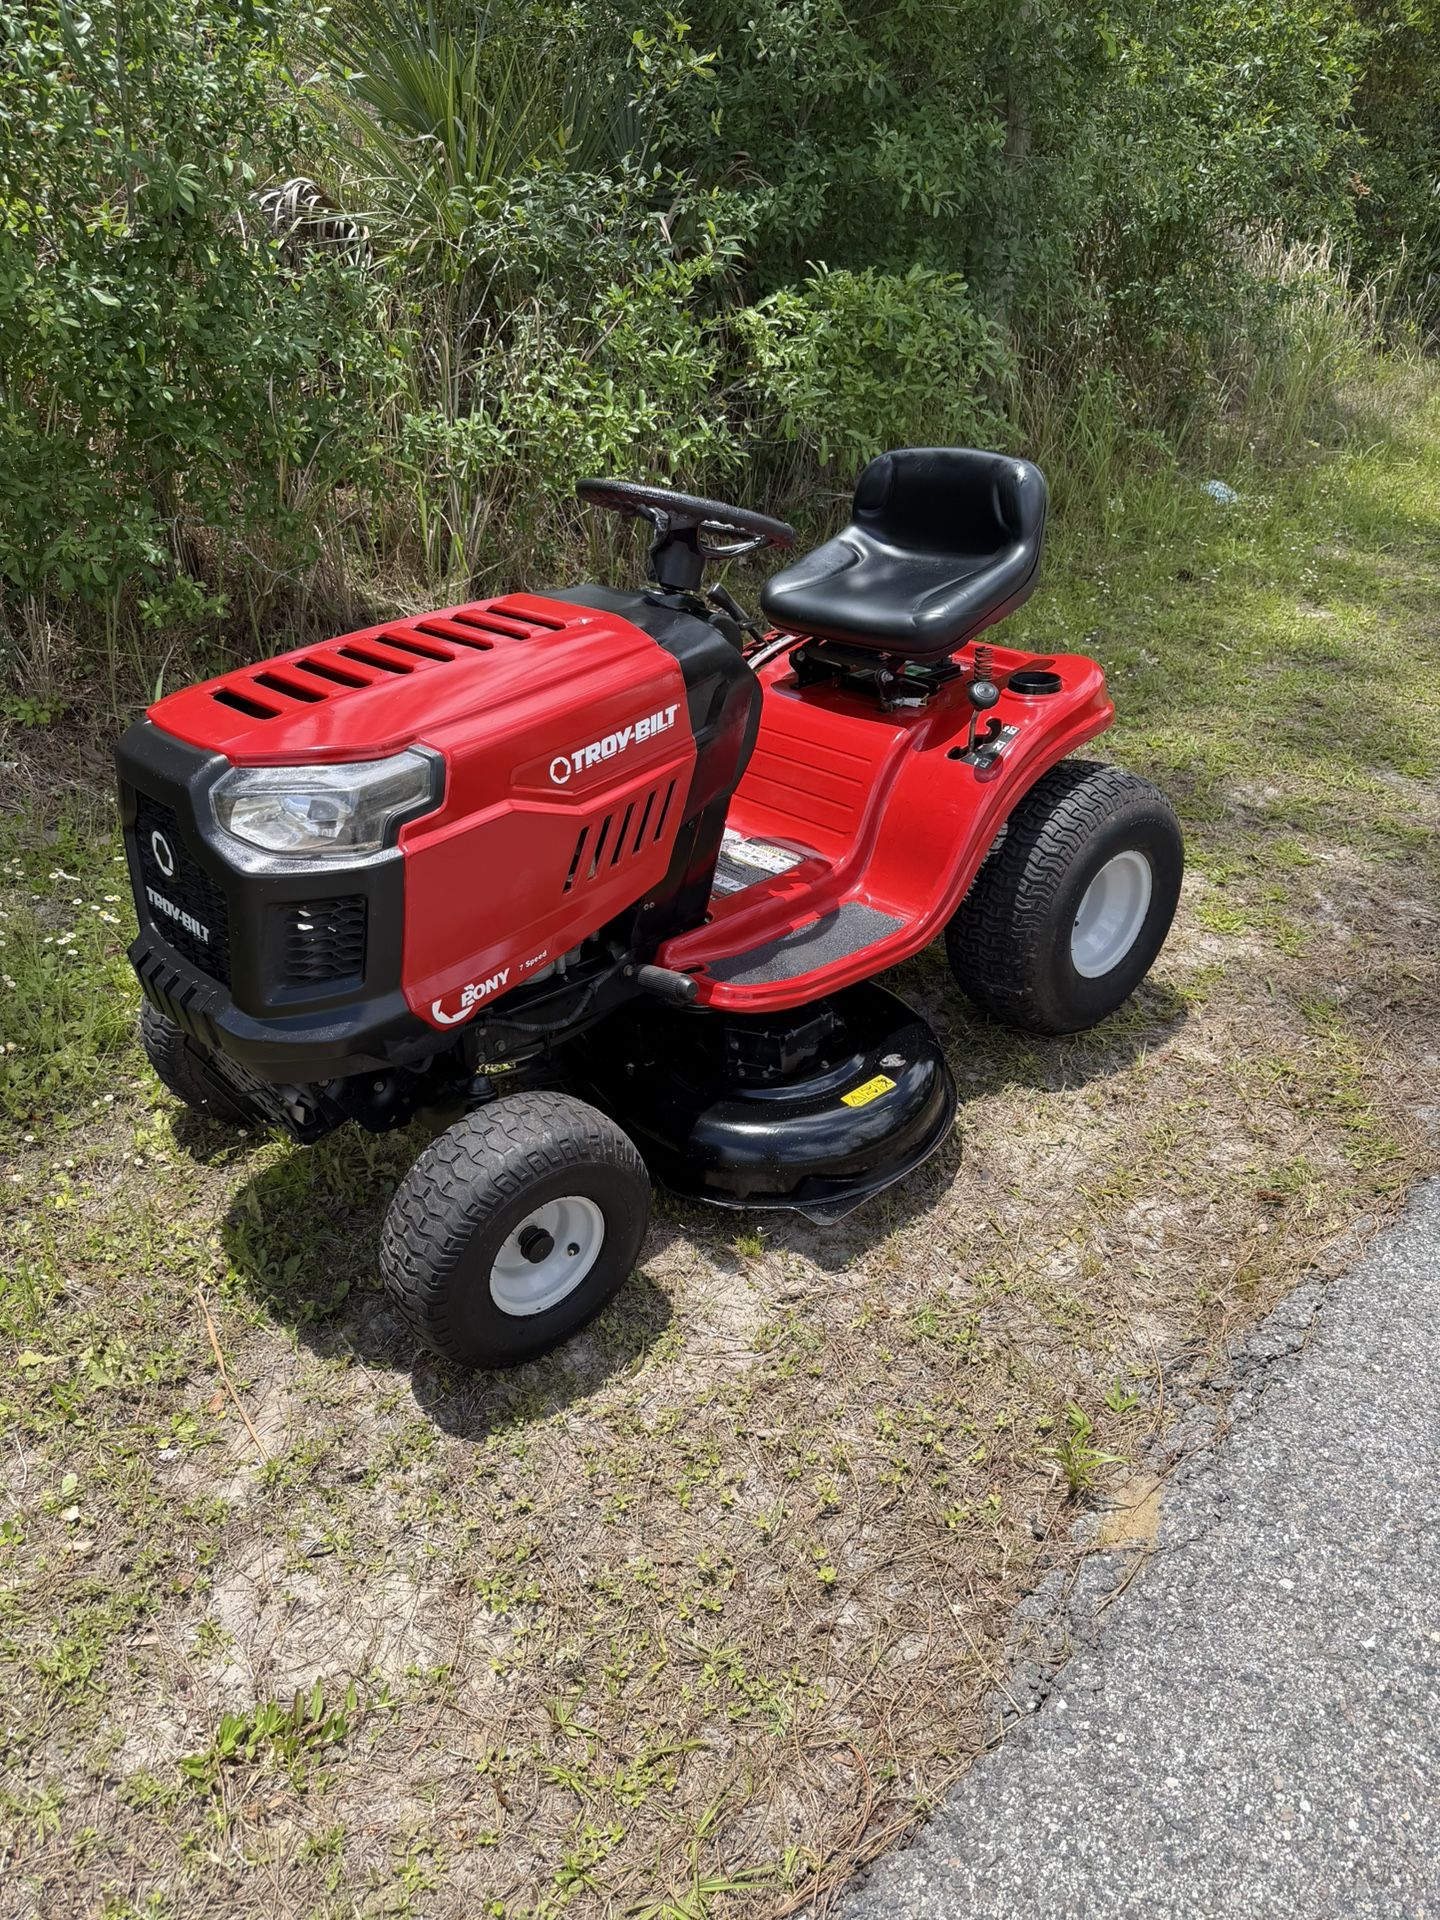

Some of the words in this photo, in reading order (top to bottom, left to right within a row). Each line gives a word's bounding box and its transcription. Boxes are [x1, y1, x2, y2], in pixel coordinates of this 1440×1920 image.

[571, 703, 678, 774] TROY-BILT
[145, 885, 210, 945] TROY-BILT
[525, 949, 548, 969] Speed
[461, 967, 510, 1008] PONY
